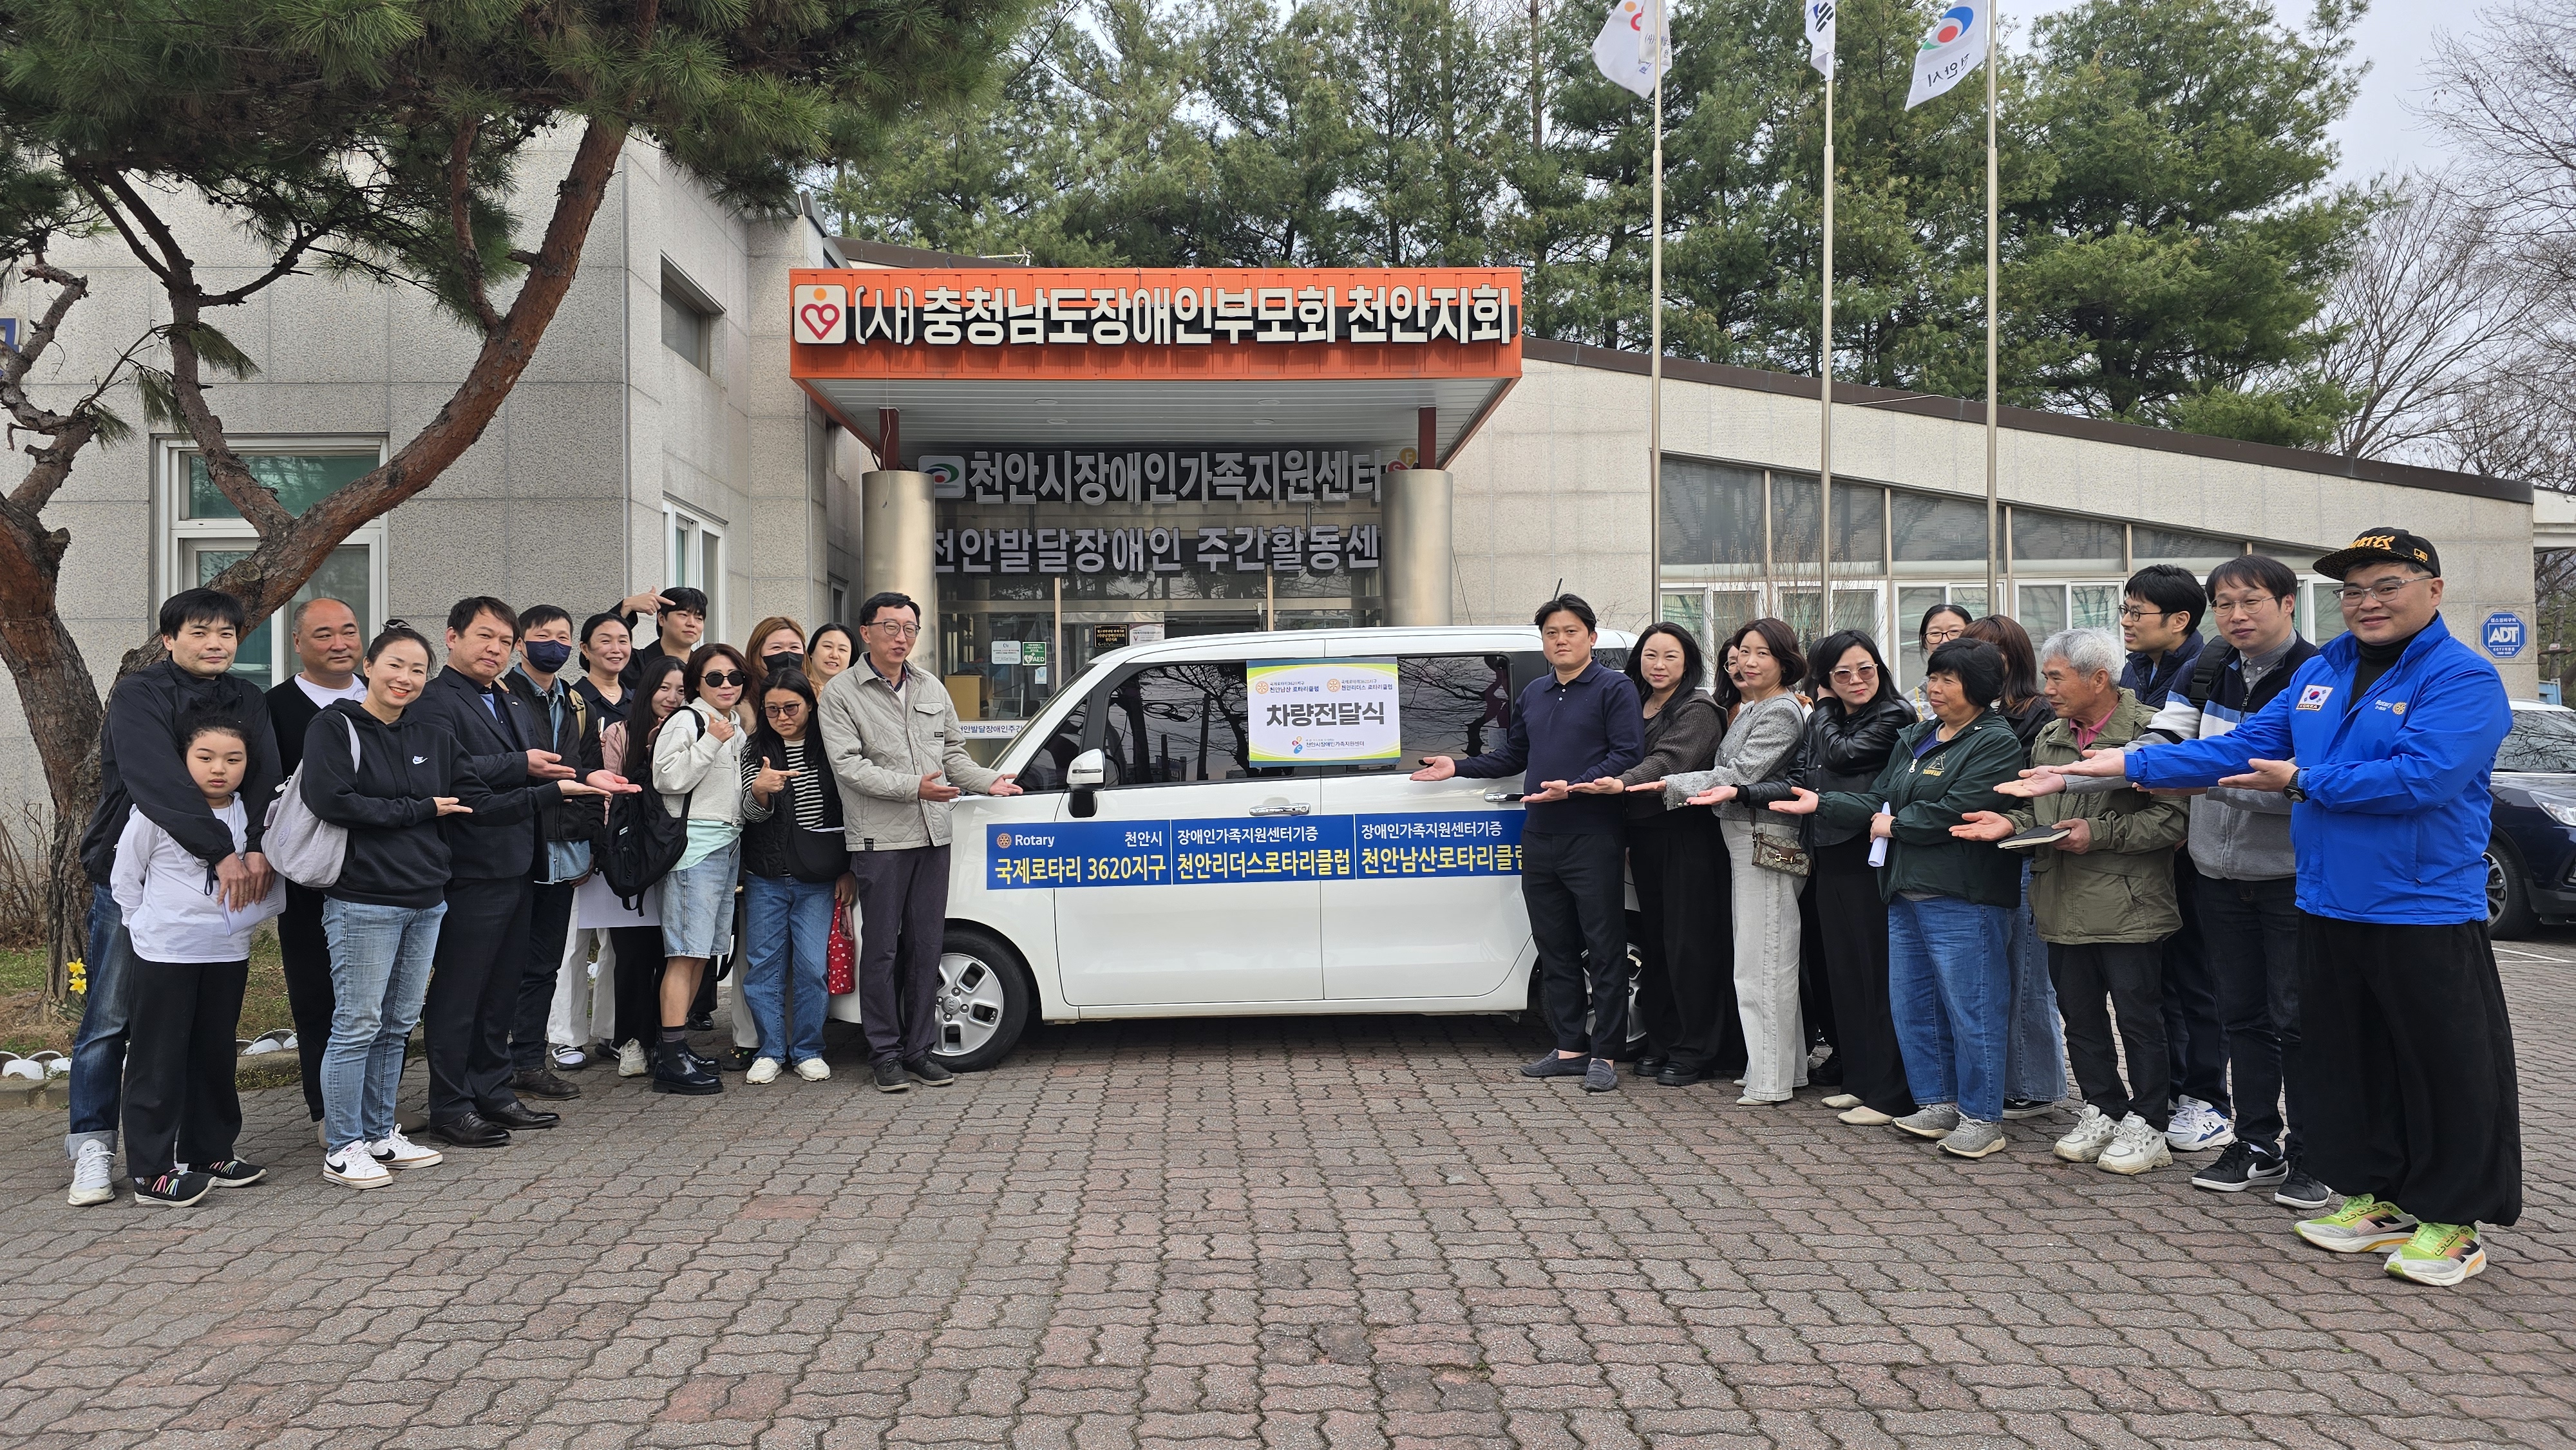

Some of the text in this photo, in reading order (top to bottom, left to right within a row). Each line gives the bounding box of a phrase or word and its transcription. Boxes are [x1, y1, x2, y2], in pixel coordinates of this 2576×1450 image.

[1349, 283, 1510, 344] 천안지회
[969, 449, 1381, 505] 천안시장애인가족지원센터
[1197, 524, 1379, 572] 주간활동센
[2490, 626, 2518, 643] ADT
[1266, 701, 1385, 727] 차량전달식
[1015, 834, 1055, 847] Rotary
[1124, 831, 1162, 847] 천안시
[1177, 826, 1319, 845] 장애인가족지원센터기증
[1361, 821, 1503, 840] 장애인가족지원센터기증
[995, 854, 1166, 884] 국제로타리 3620지구
[1177, 849, 1350, 880] 천안리더스로타리클럽
